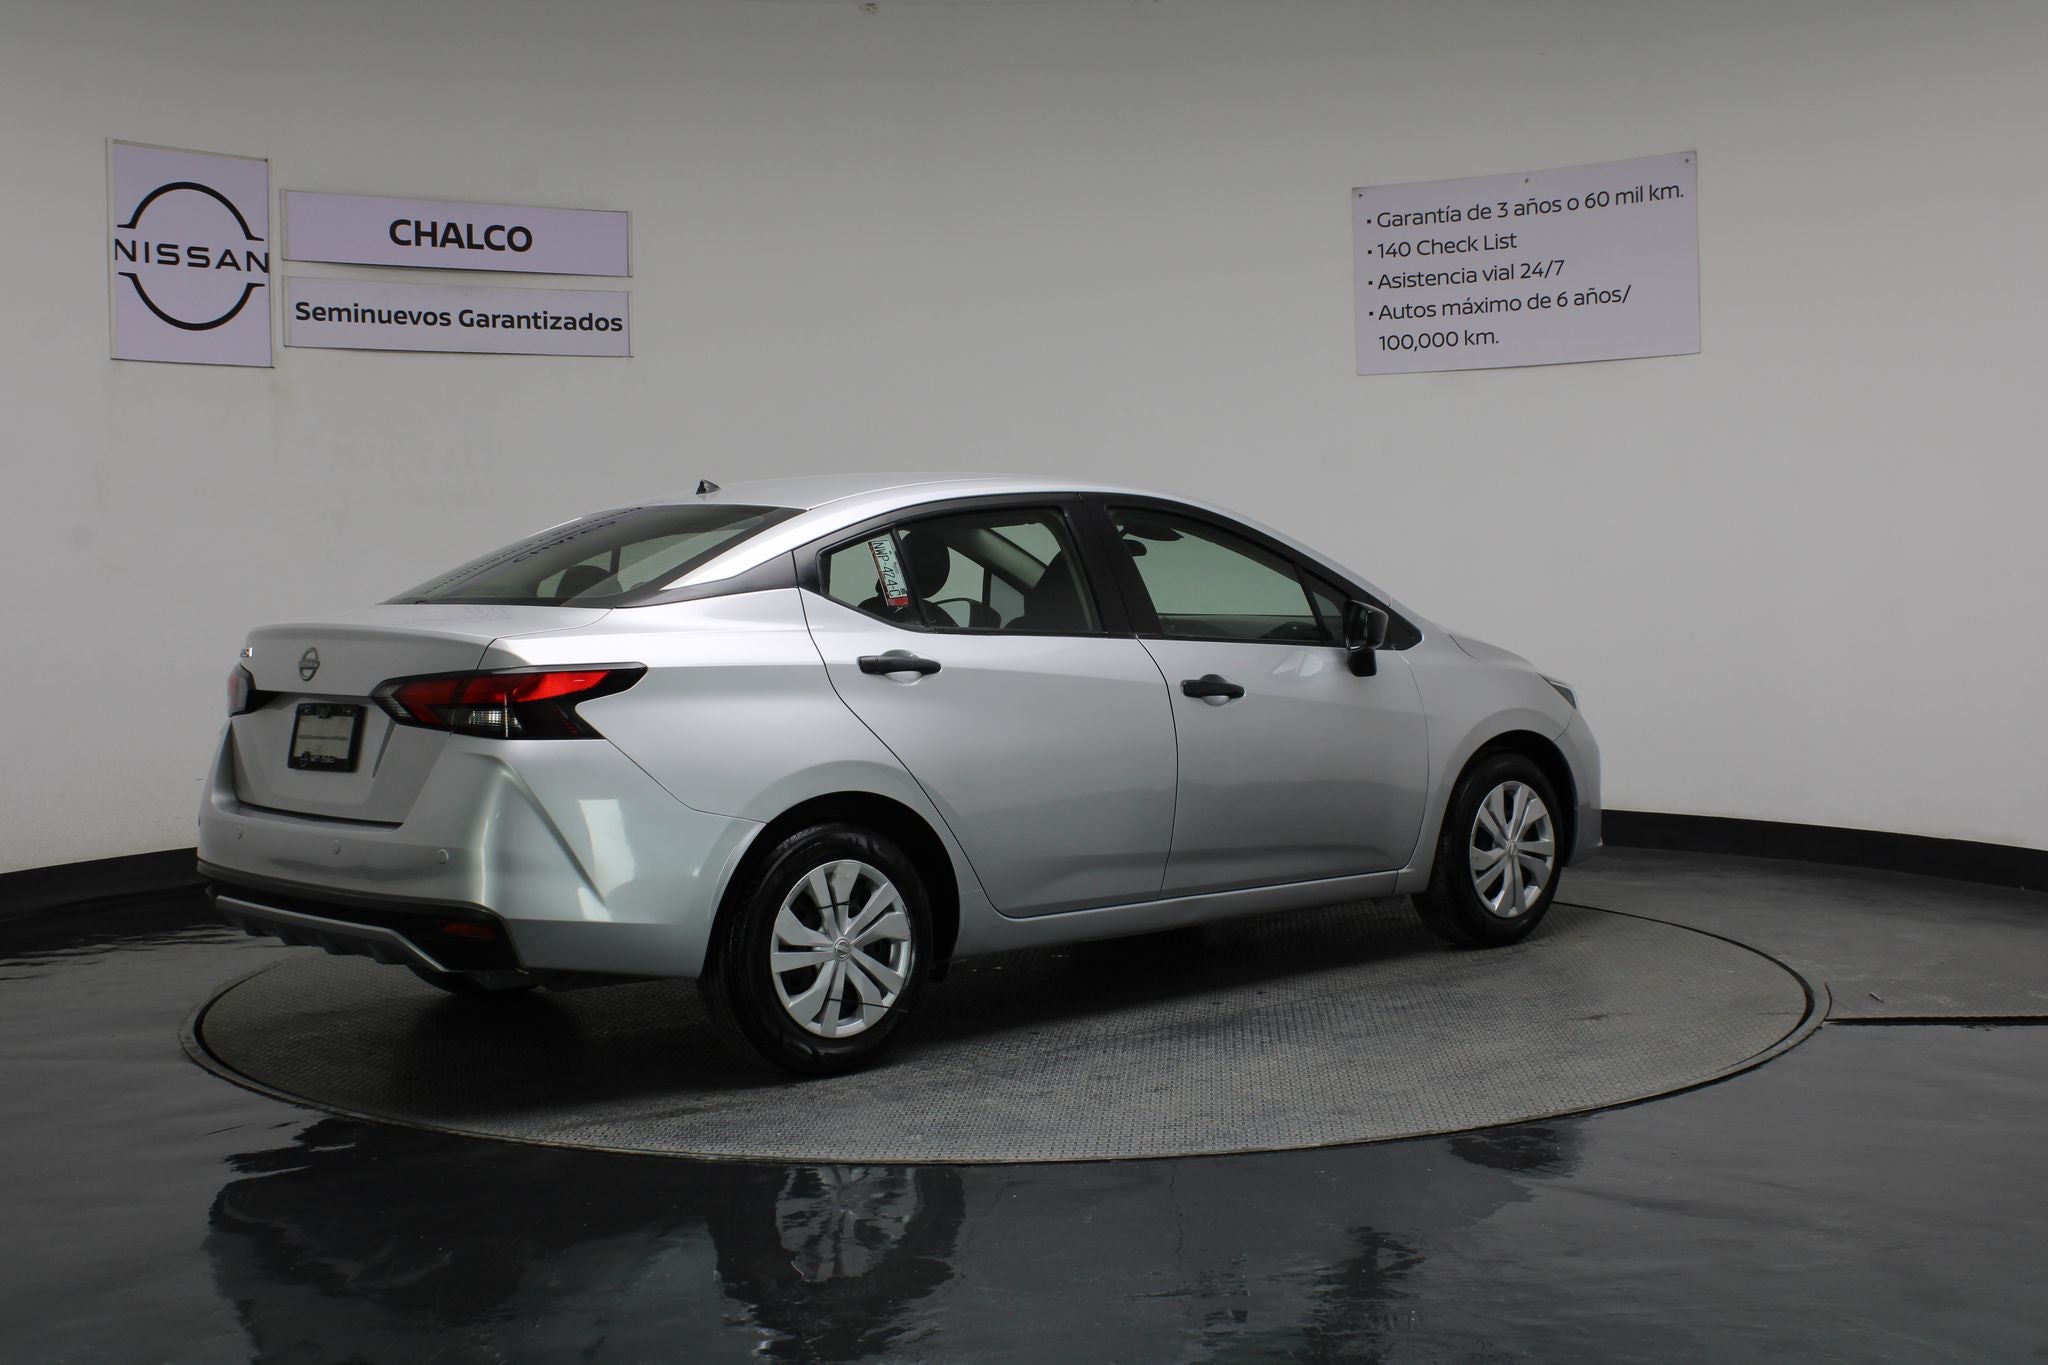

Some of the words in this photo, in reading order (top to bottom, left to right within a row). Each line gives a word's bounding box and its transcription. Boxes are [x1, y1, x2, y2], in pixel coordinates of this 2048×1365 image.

[1377, 204, 1462, 228] Garantía
[1467, 204, 1492, 221] de
[1496, 202, 1509, 219] 3
[1514, 197, 1562, 217] años
[1566, 197, 1580, 211] o
[1584, 190, 1610, 209] 60
[1615, 186, 1644, 206] mil
[1649, 184, 1684, 202] km.
[388, 218, 533, 253] CHALCO
[1377, 241, 1412, 259] 140
[1416, 235, 1479, 256] Check
[1483, 232, 1518, 251] List
[114, 238, 270, 274] NISSAN
[1377, 270, 1478, 290] Asistencia
[1482, 263, 1515, 282] vial
[1519, 259, 1565, 280] 24/7
[294, 300, 452, 328] Seminuevos
[458, 308, 624, 333] Garantizados
[1378, 304, 1437, 321] Autos
[1441, 296, 1522, 317] máximo
[1526, 292, 1552, 310] de
[1556, 290, 1569, 308] 6
[1573, 285, 1632, 307] años/
[1378, 331, 1459, 352] 100,000
[1464, 328, 1500, 347] km.
